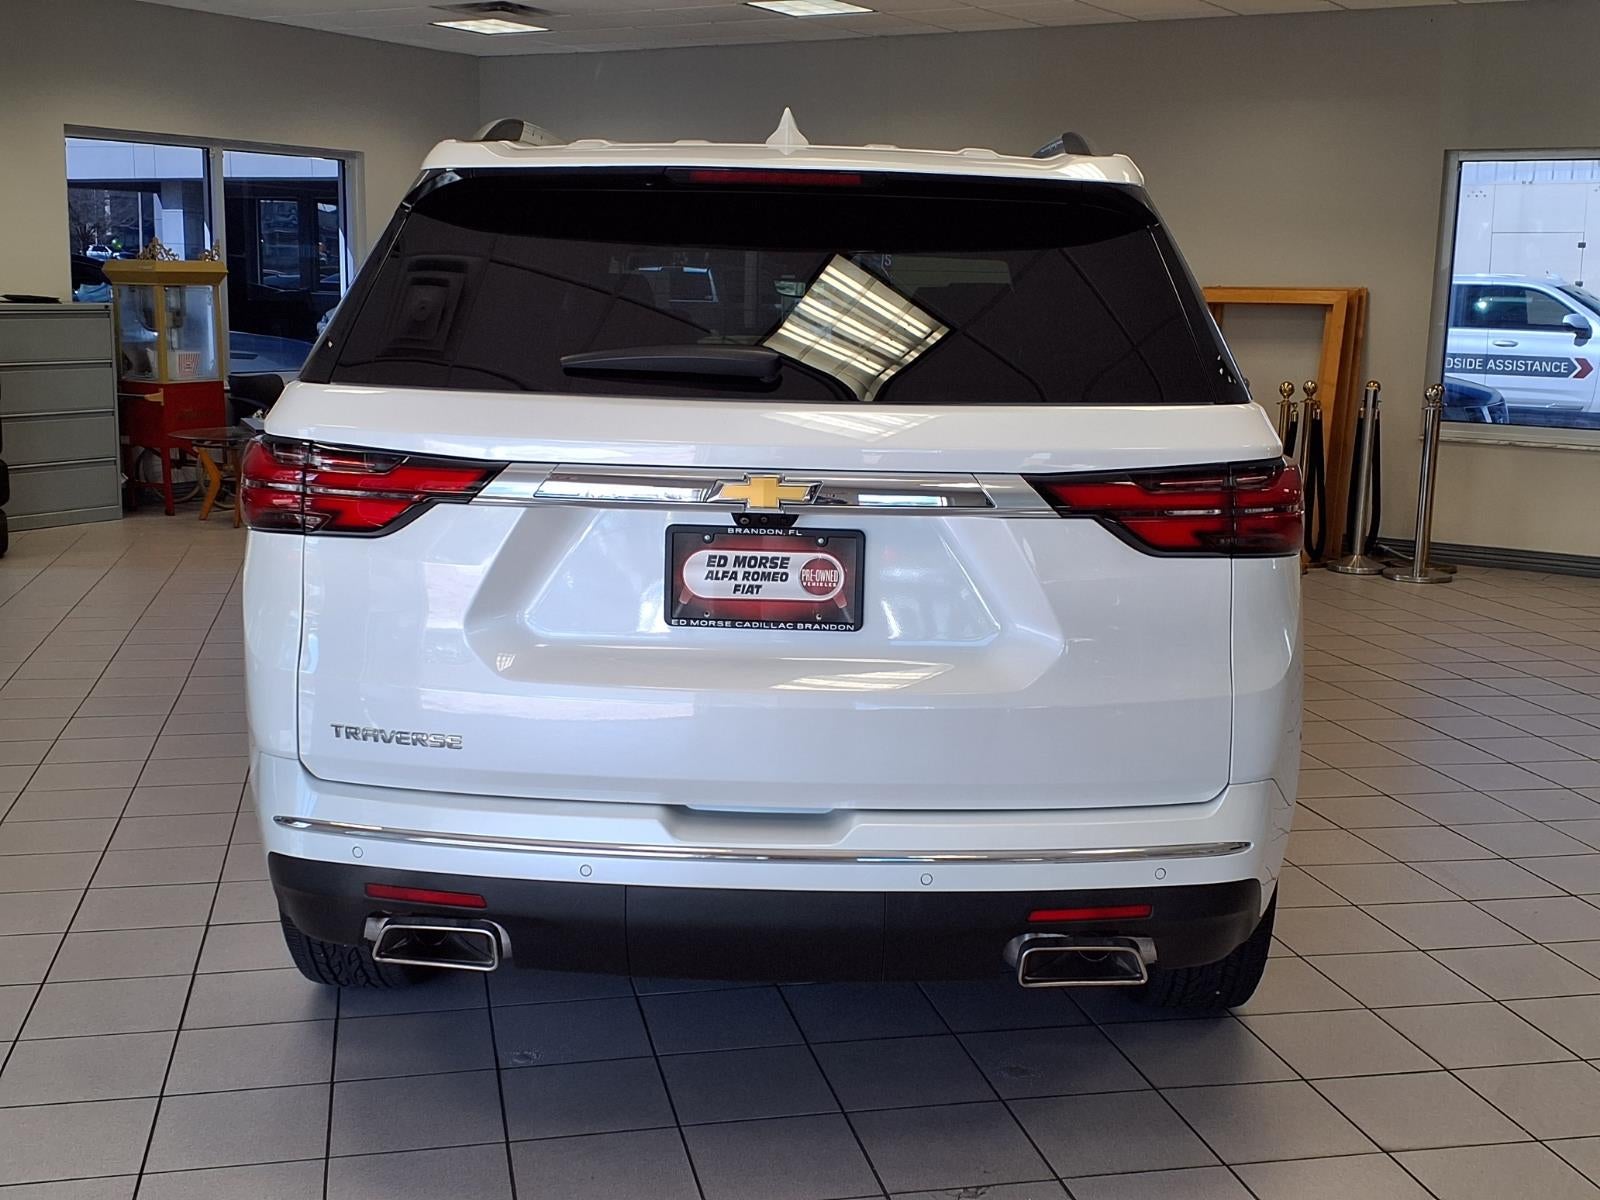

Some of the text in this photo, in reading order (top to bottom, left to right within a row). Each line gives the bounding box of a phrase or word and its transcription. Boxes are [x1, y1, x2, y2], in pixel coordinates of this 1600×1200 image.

[1486, 359, 1568, 373] ASSISTANCE
[706, 555, 790, 569] ED MORSE
[704, 570, 789, 582] ALFA ROMEO
[801, 569, 839, 582] PRE-OWNED
[732, 584, 763, 595] FIAT
[690, 619, 732, 627] MORSE
[735, 621, 794, 629] CADILLAC
[796, 623, 855, 631] BRANDON
[330, 723, 463, 750] TRAVERSE
